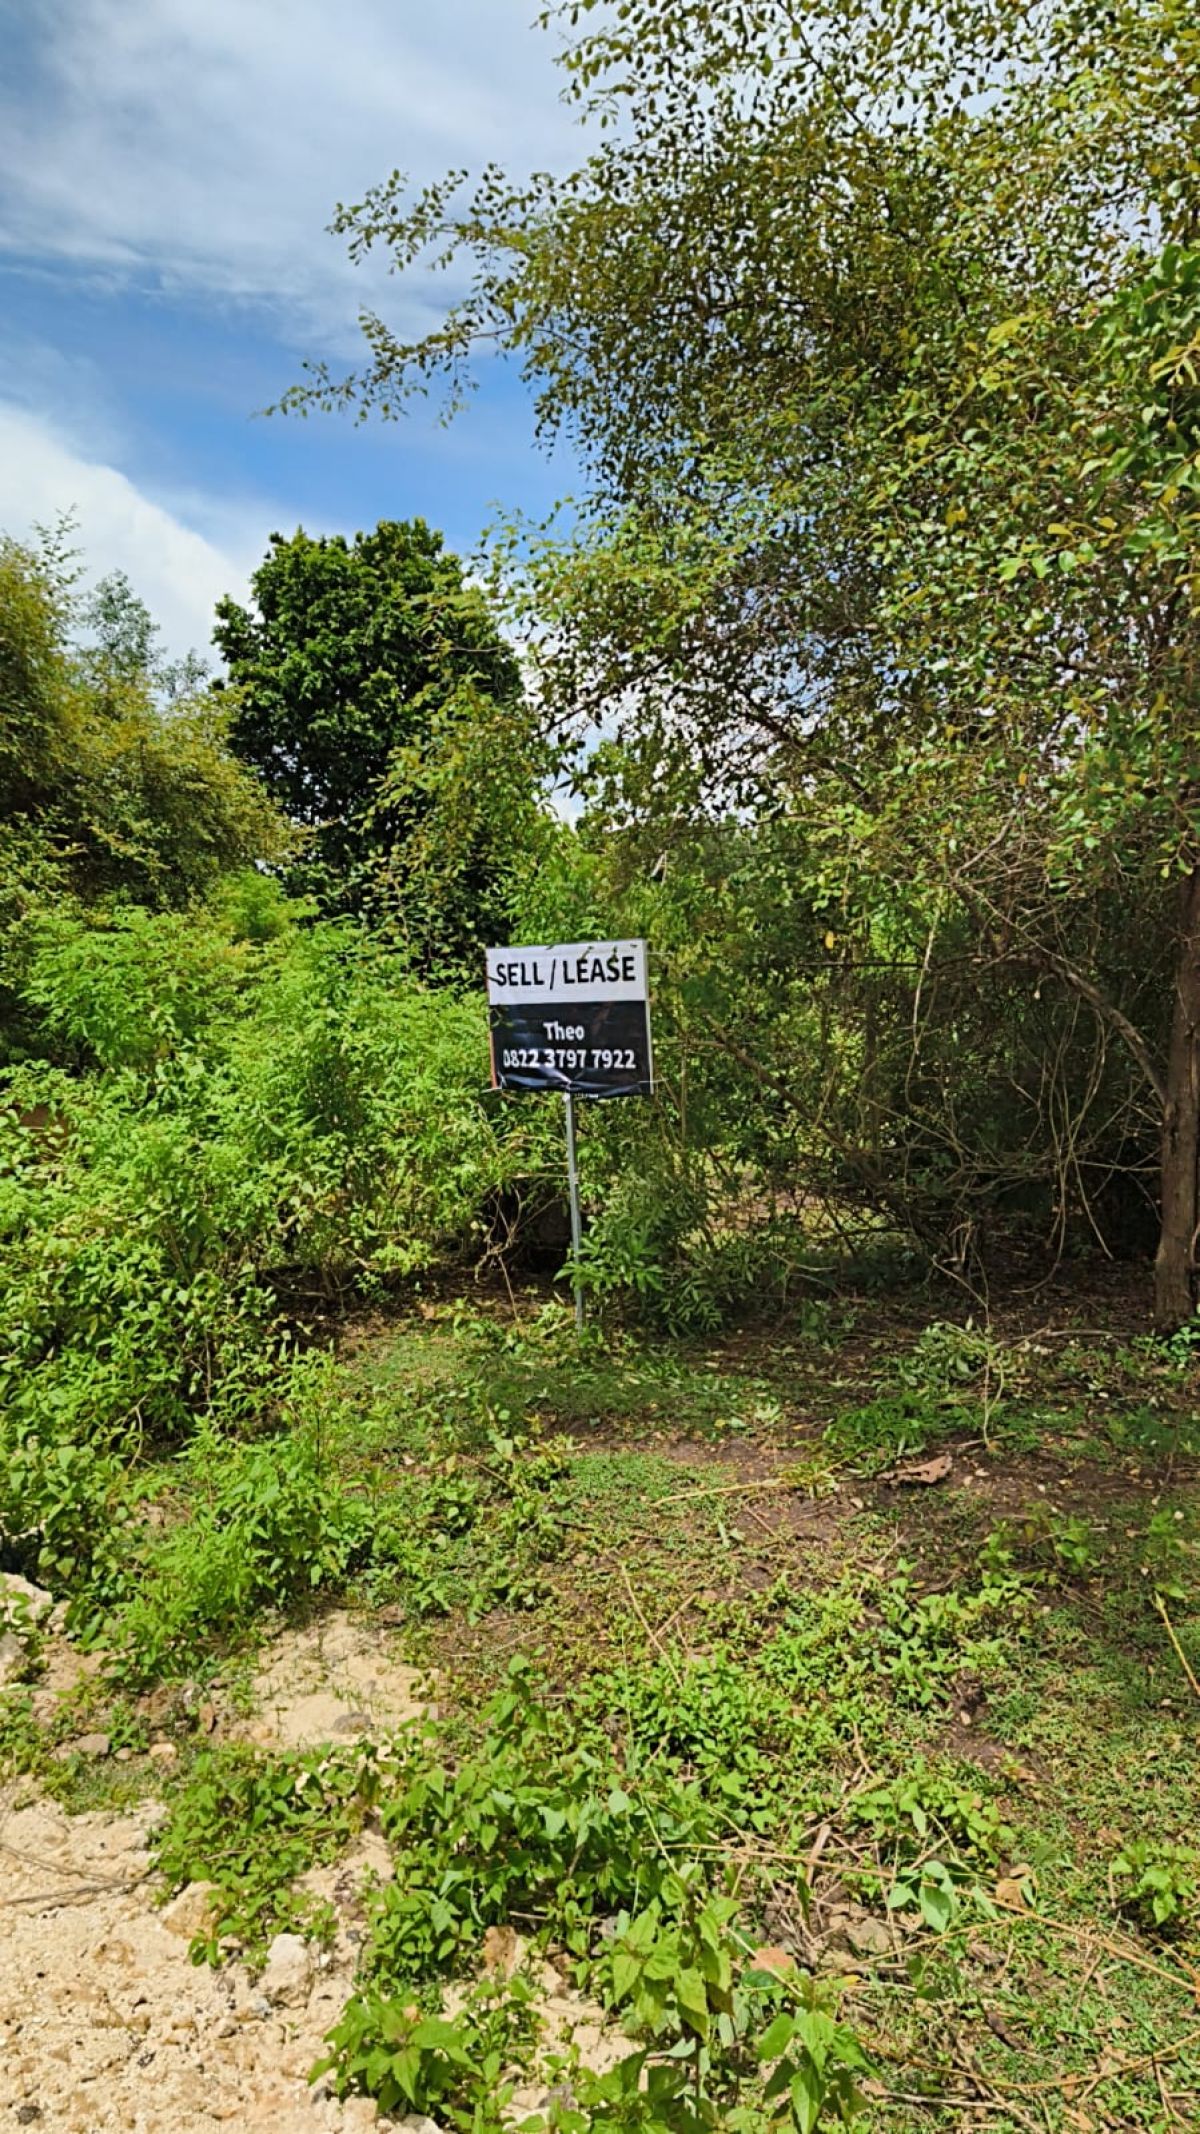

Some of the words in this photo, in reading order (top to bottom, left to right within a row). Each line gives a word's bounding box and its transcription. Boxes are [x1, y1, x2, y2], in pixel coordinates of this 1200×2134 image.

[496, 962, 545, 986] SELL
[562, 956, 636, 985] LEASE
[543, 1021, 585, 1041] Theo
[503, 1049, 540, 1068] 0822
[544, 1049, 587, 1069] 3797
[591, 1049, 636, 1069] 7922
